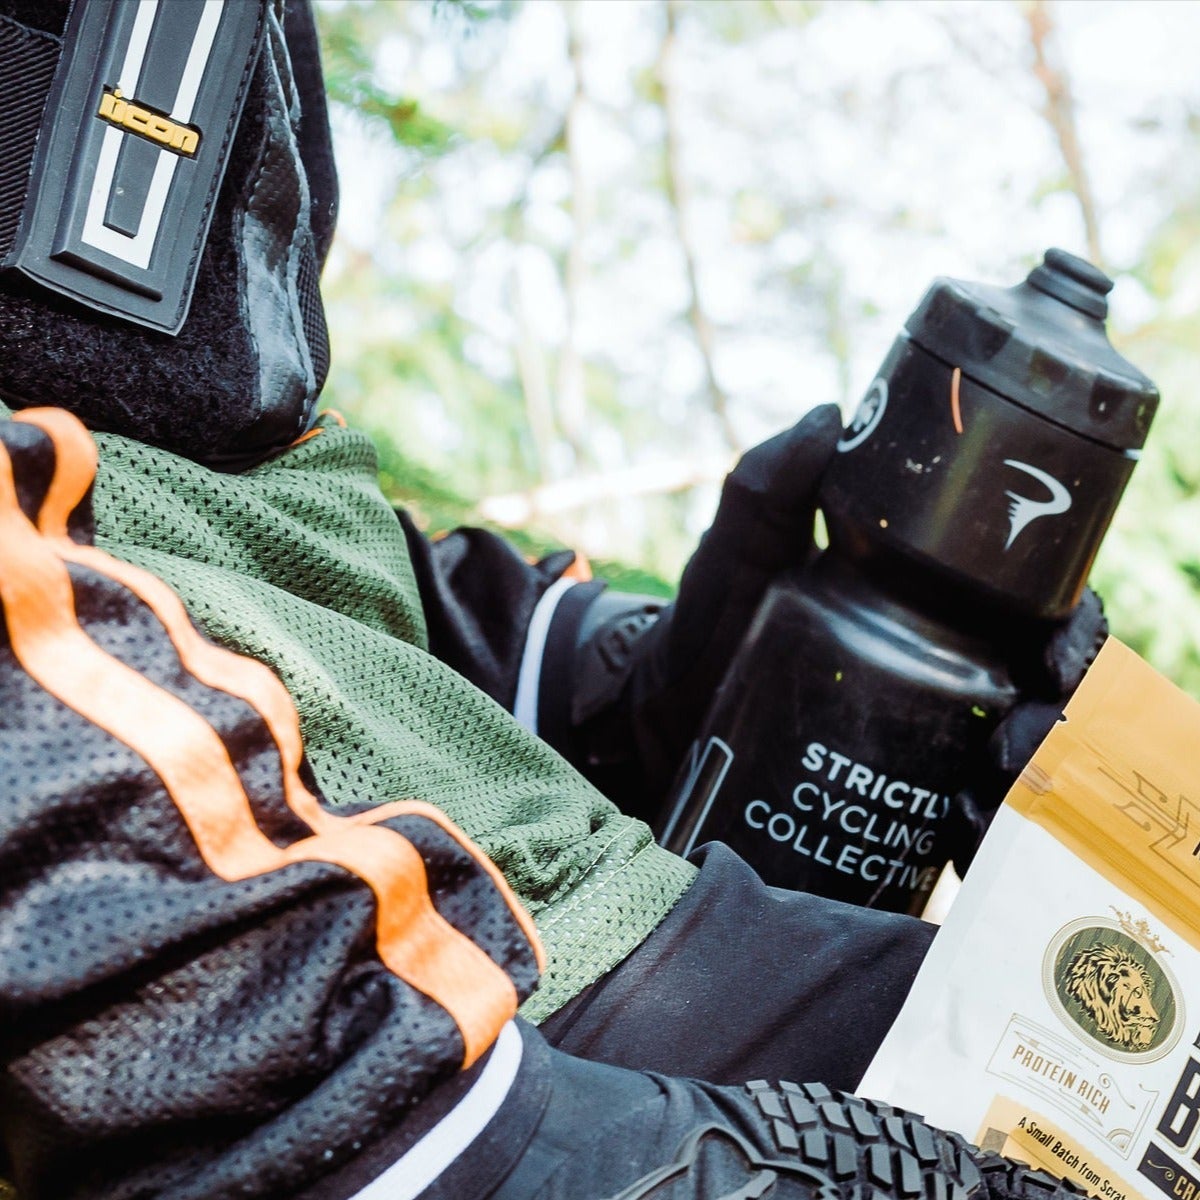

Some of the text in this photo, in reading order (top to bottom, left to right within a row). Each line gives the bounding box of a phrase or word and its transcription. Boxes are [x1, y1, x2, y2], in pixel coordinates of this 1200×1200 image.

[793, 782, 936, 855] CYCLING
[1012, 1044, 1111, 1114] PROTEIN RICH
[1018, 1116, 1027, 1128] A
[1026, 1121, 1054, 1148] Small
[1051, 1141, 1080, 1169] Batch
[1078, 1162, 1101, 1186] from
